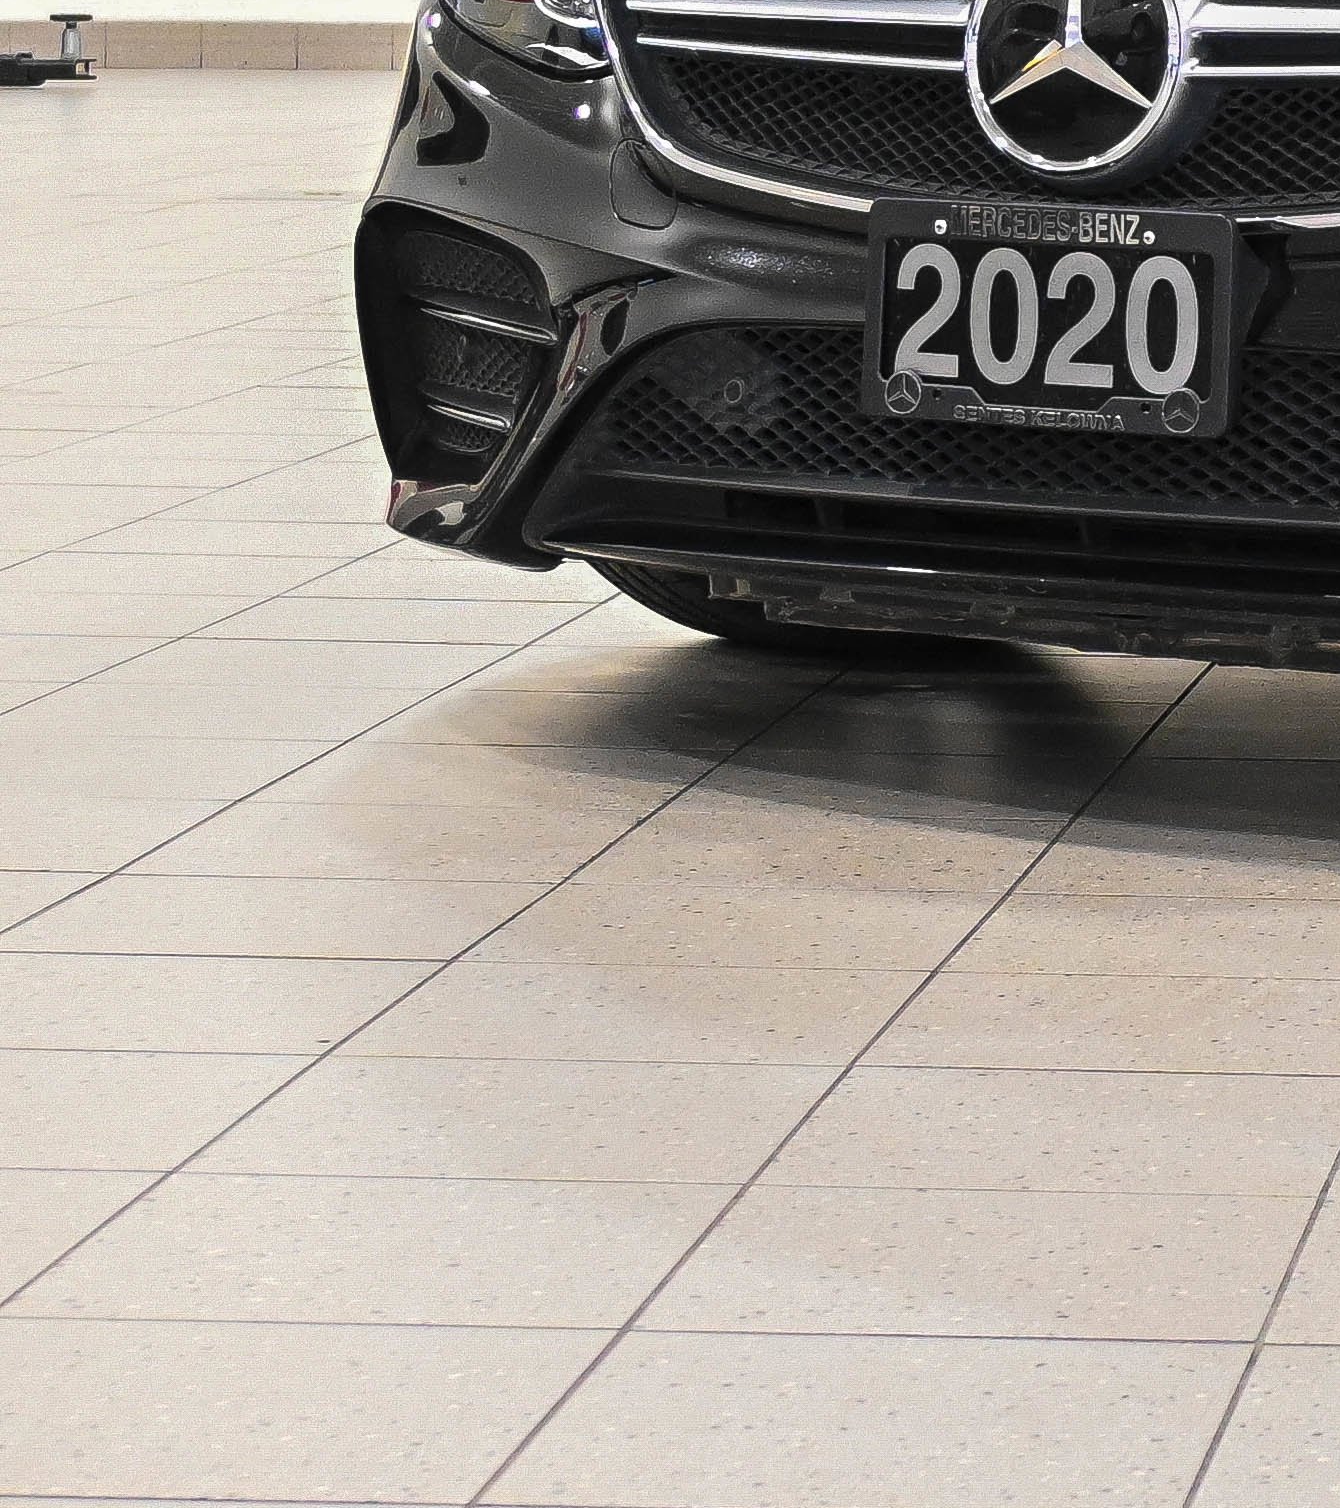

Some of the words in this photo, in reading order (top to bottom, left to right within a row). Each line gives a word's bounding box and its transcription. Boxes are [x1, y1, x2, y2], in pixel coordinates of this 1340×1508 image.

[949, 204, 1141, 245] MERCEDES-BENZ
[893, 242, 1200, 396] 2020
[1030, 410, 1126, 432] KELOWNA
